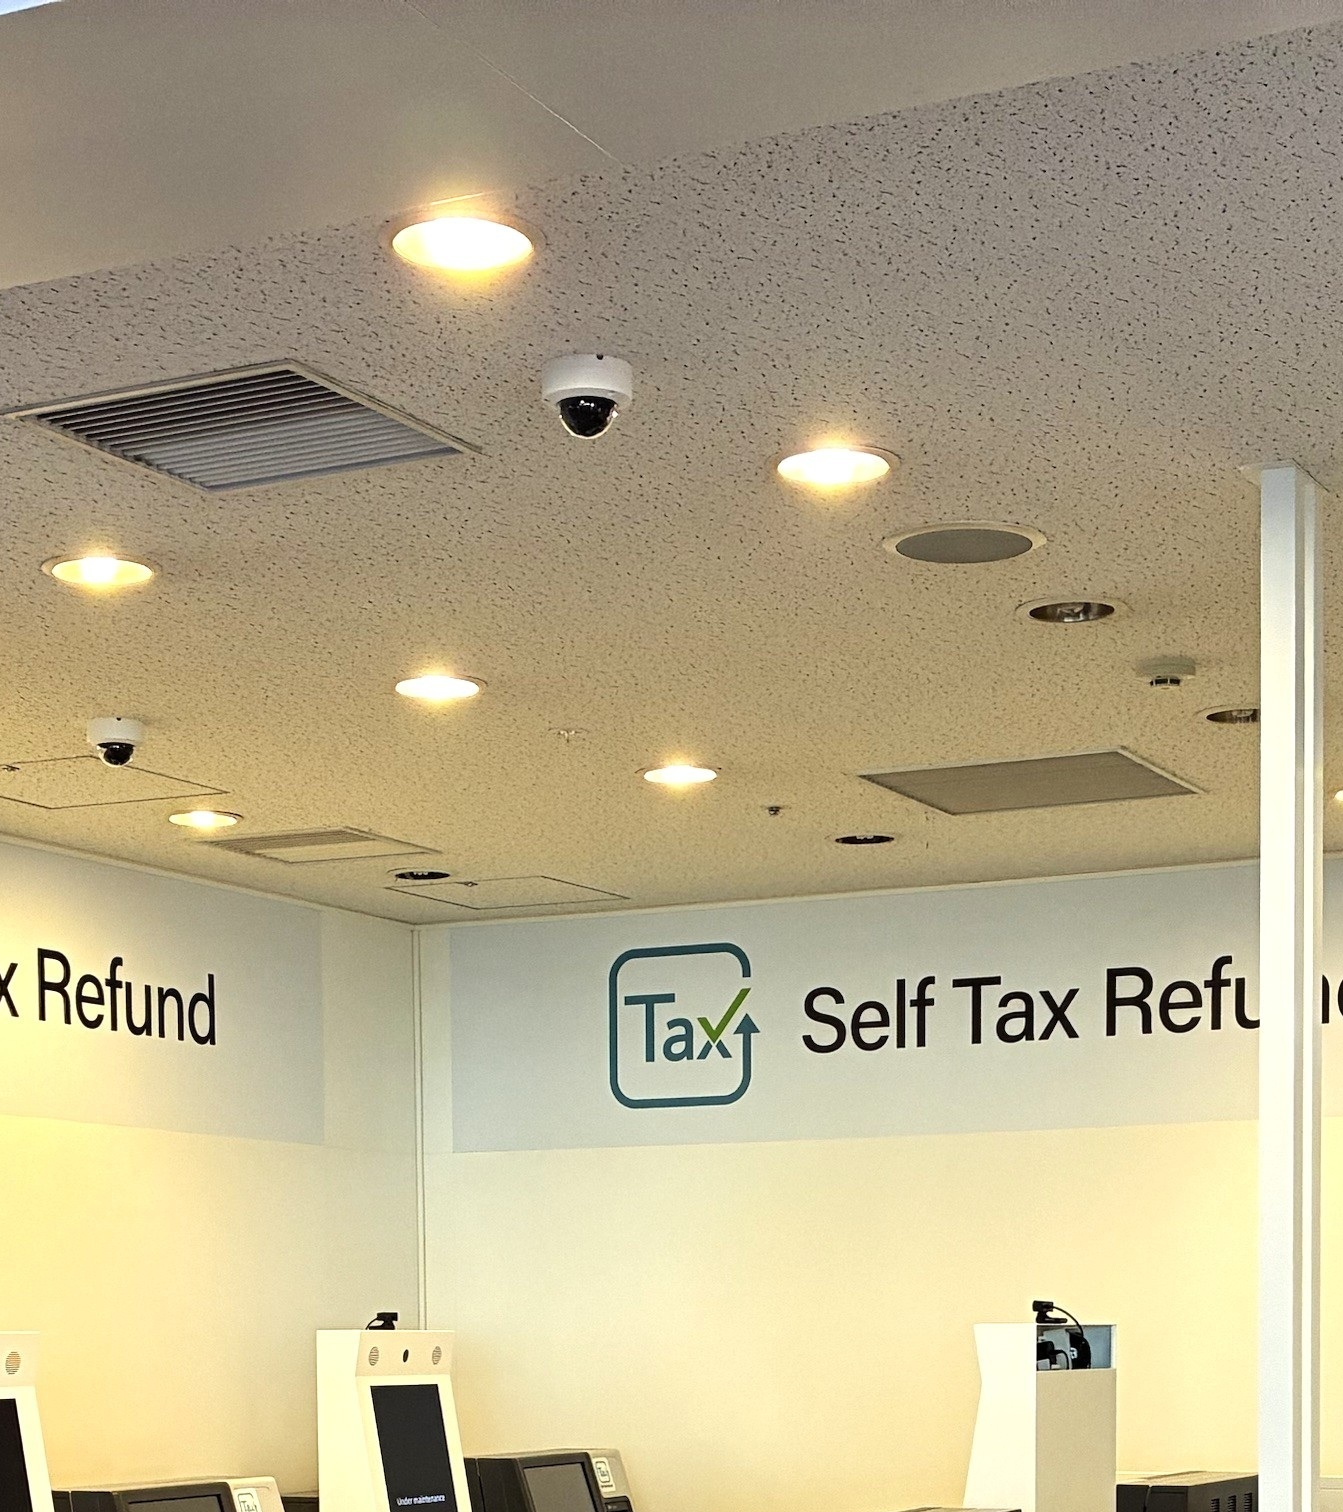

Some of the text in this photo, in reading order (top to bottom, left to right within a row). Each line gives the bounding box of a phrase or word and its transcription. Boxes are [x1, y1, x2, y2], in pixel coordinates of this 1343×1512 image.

[37, 947, 217, 1046] Refund
[624, 987, 752, 1063] Tax
[801, 975, 937, 1054] Self
[952, 975, 1080, 1047] Tax
